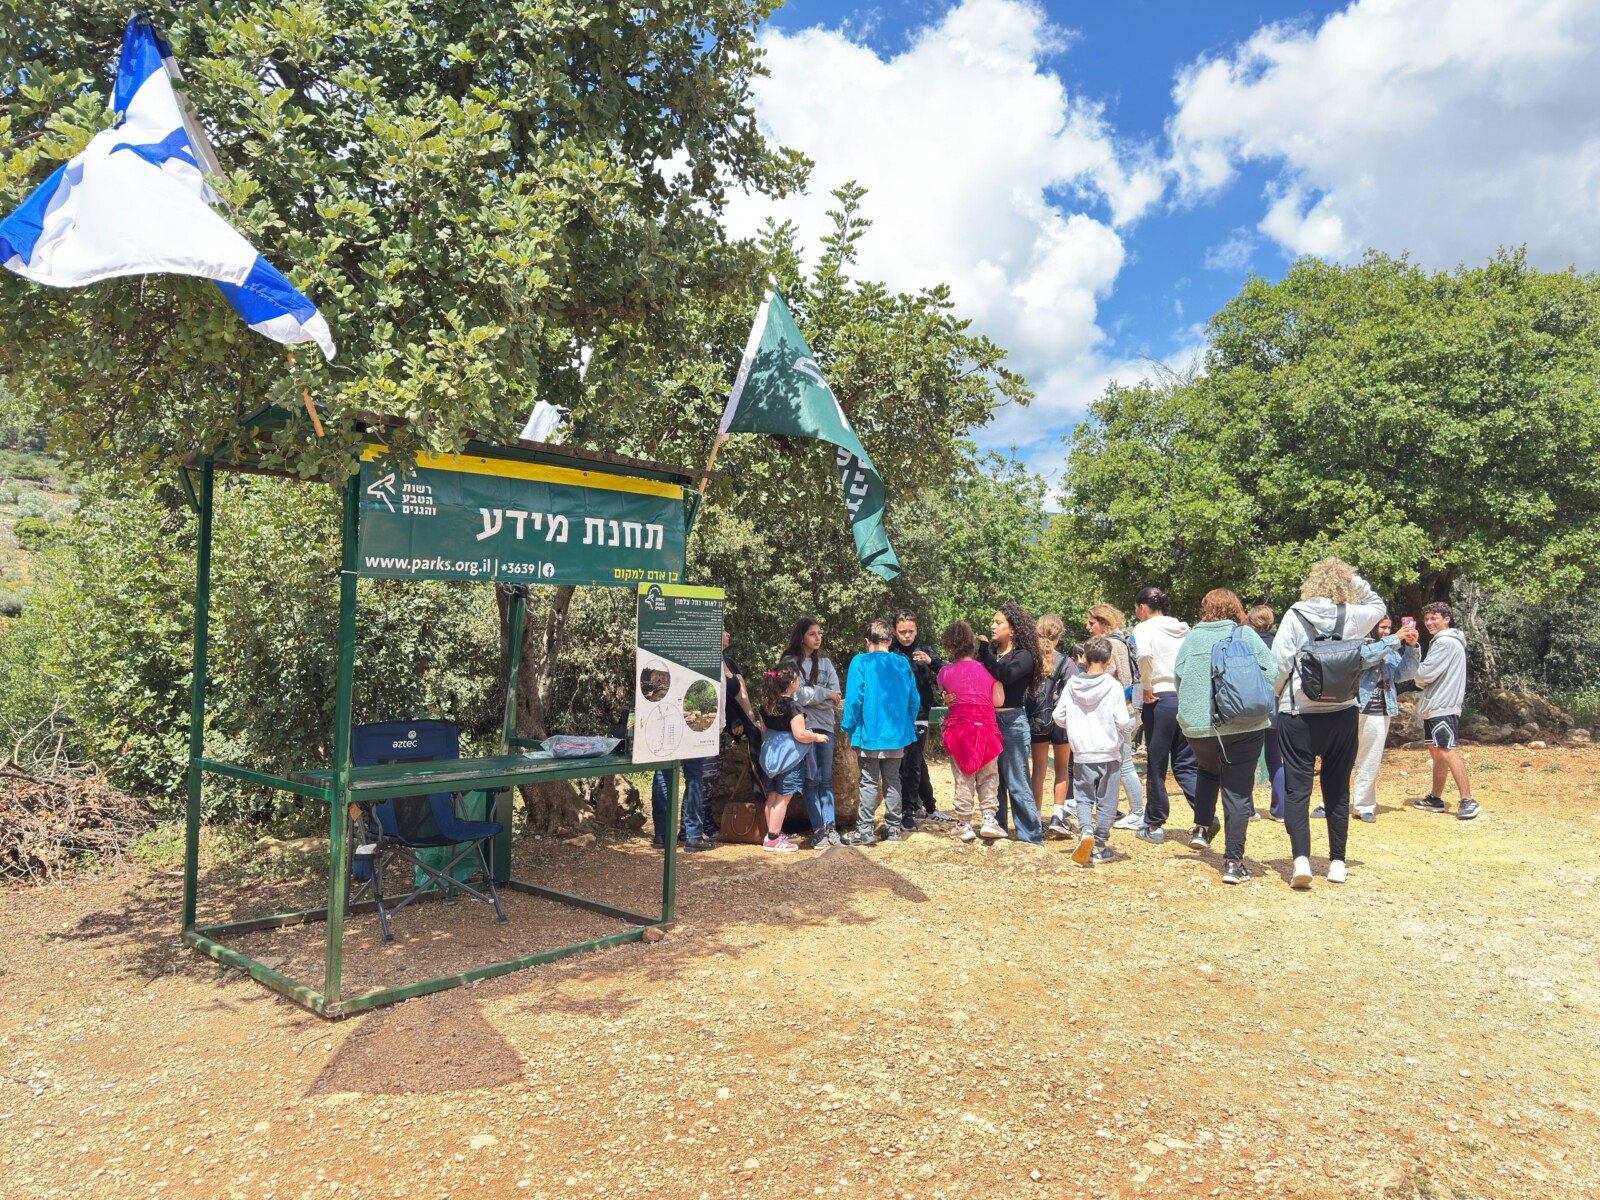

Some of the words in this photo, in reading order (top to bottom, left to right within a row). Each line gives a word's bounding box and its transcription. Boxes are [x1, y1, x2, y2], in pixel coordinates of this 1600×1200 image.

[402, 483, 432, 494] רשות
[402, 494, 434, 505] הטבע
[402, 505, 437, 516] והגנים
[475, 507, 569, 543] מידע
[582, 517, 664, 550] תחנת
[364, 556, 491, 577] www.parks.org.il
[614, 568, 645, 582] למקום
[647, 570, 666, 581] אדם
[668, 572, 679, 583] בן
[392, 740, 418, 748] aztec
